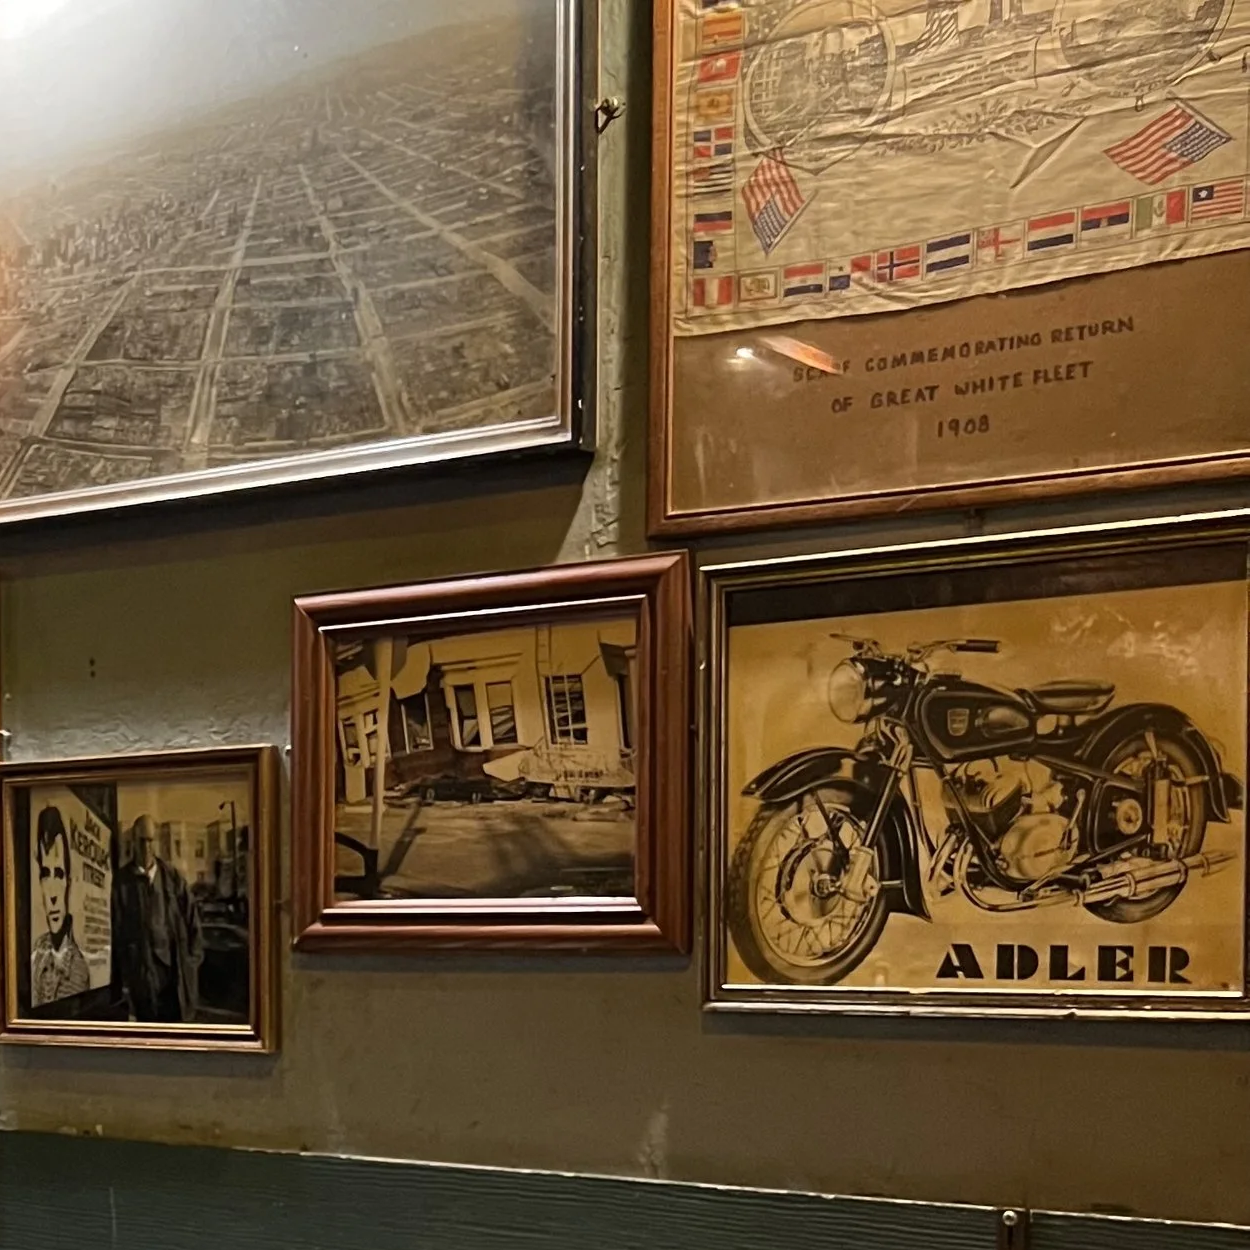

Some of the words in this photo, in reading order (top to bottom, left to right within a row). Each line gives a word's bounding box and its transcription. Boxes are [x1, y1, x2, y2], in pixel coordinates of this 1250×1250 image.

[865, 331, 1042, 373] COMMEMORATING
[1051, 316, 1134, 343] RETURN
[831, 397, 853, 414] OF
[870, 385, 940, 409] GREAT
[954, 372, 1023, 396] WHITE
[1033, 361, 1094, 385] FLEET
[937, 415, 990, 438] 1908
[936, 944, 1192, 984] ADLER
